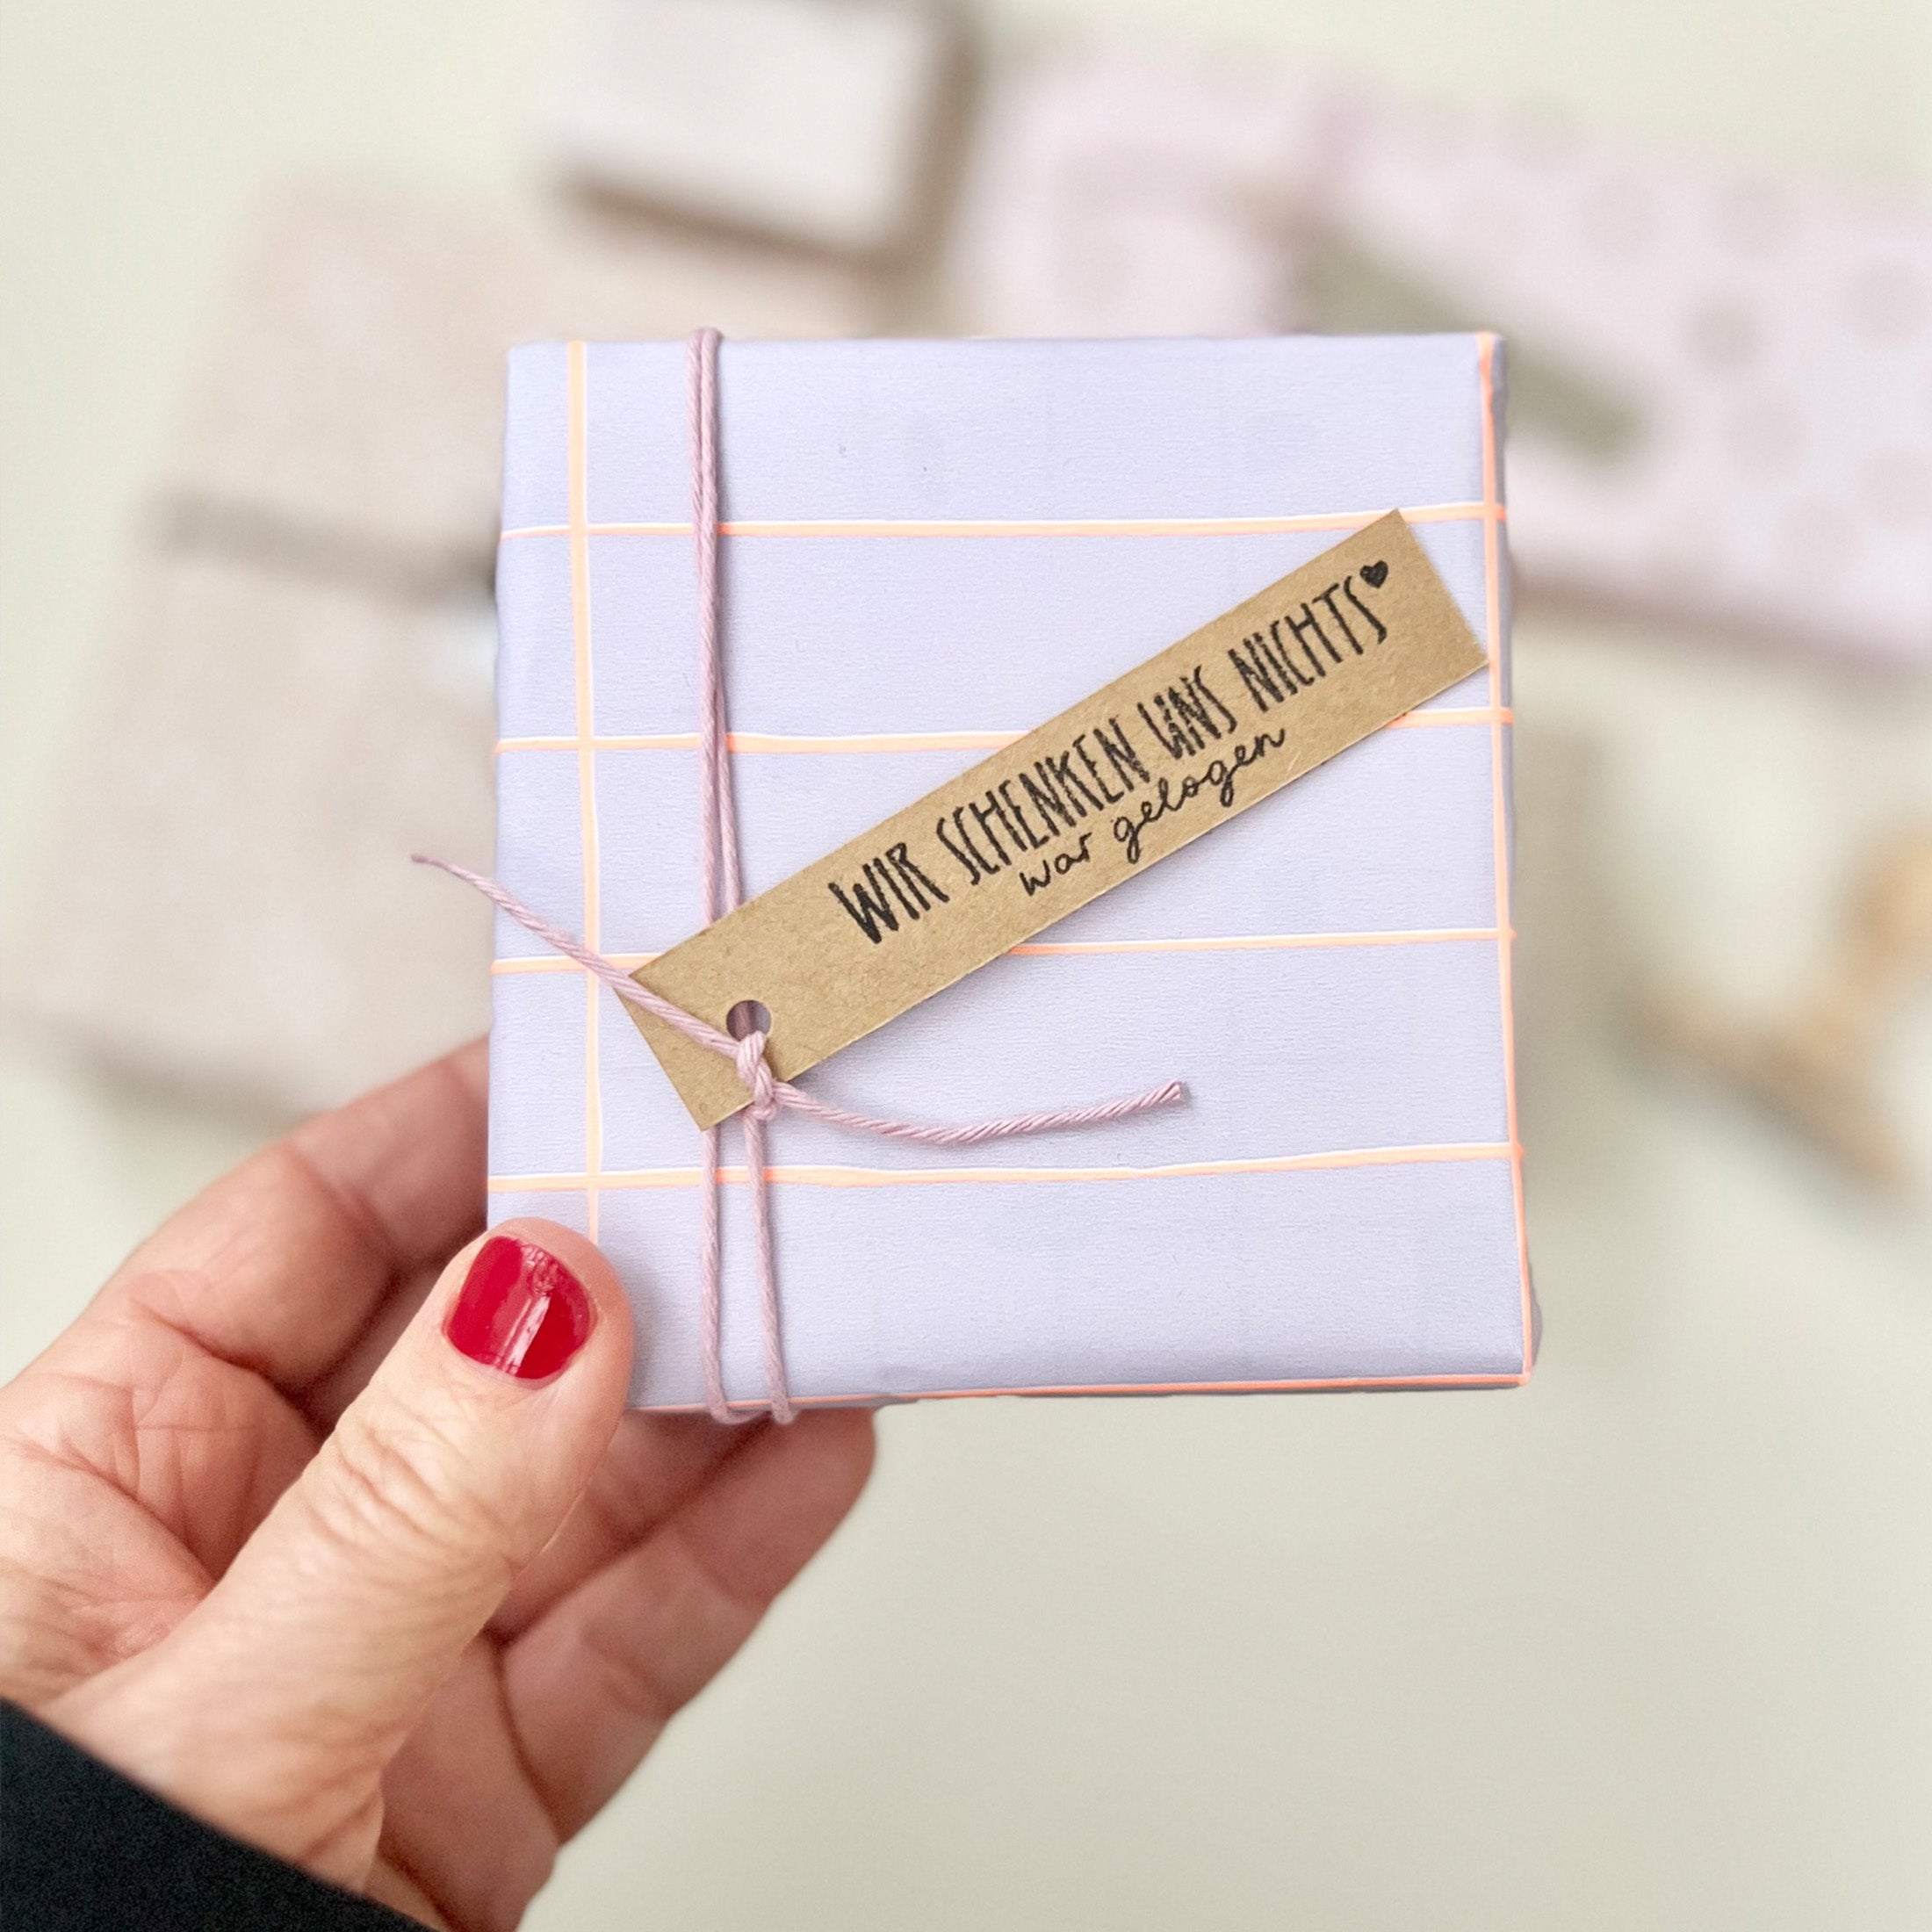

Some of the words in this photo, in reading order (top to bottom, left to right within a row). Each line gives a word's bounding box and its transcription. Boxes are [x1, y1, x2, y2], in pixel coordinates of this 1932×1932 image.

[828, 841, 949, 944] WIR
[935, 717, 1151, 885] SCHENKEN
[1136, 665, 1237, 761] UNS
[1227, 575, 1388, 712] NICHTS
[1019, 829, 1093, 896] war
[1113, 727, 1286, 865] gelogen
